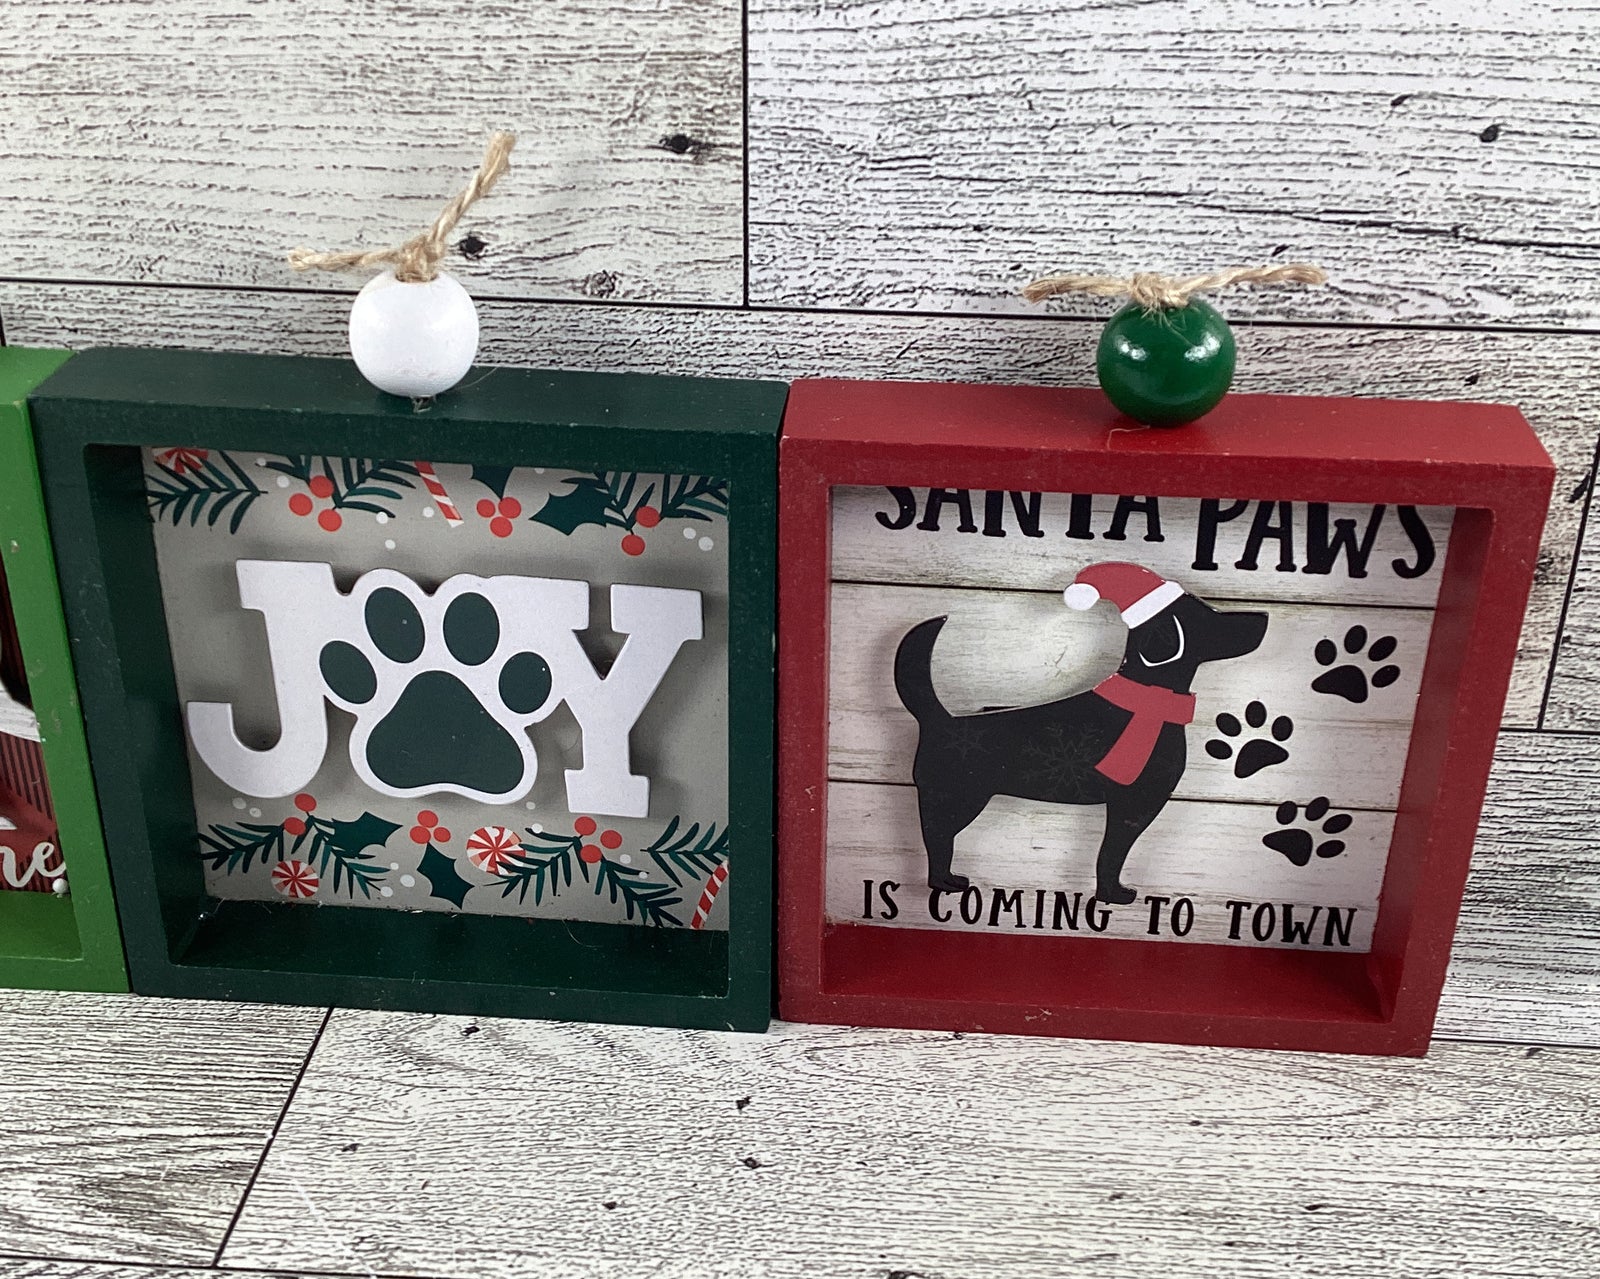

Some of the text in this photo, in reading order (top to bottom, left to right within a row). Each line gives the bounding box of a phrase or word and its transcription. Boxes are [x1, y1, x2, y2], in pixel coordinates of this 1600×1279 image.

[1191, 498, 1436, 578] PAWS
[862, 879, 1358, 947] IS COMING TO TOWN
